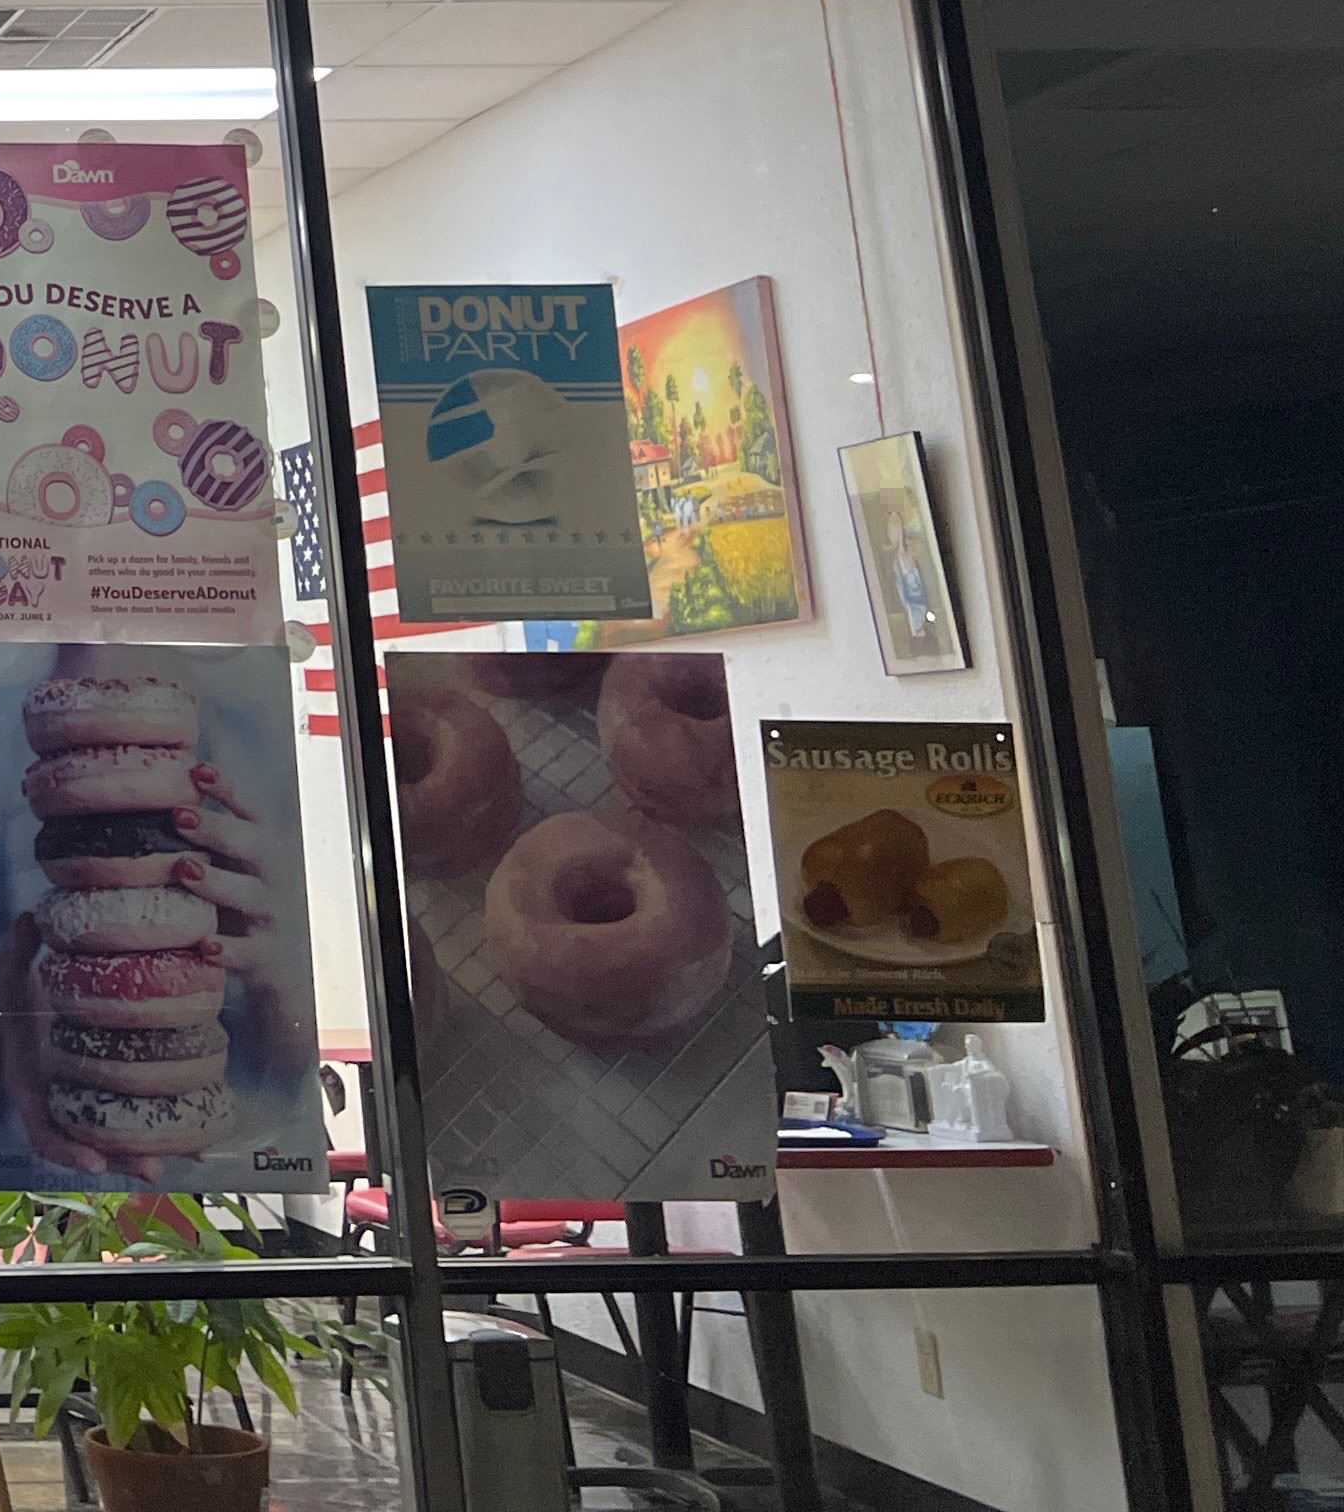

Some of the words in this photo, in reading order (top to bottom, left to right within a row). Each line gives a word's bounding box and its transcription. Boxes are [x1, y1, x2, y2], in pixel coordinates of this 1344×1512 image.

[53, 163, 114, 184] Dawn
[46, 283, 173, 320] DESERVE
[182, 293, 202, 316] A
[418, 295, 588, 332] DONUT
[421, 330, 589, 362] PARTY
[87, 554, 105, 564] Pick
[107, 556, 119, 565] up
[129, 554, 154, 564] dozen
[156, 554, 168, 564] for
[202, 554, 231, 564] friends
[88, 567, 116, 577] others
[118, 568, 137, 576] who
[152, 567, 174, 578] good
[188, 569, 206, 578] your
[90, 585, 257, 601] #YouDeserveADonut
[20, 612, 44, 621] JUNE
[46, 612, 52, 621] 2
[115, 605, 128, 613] the
[767, 741, 915, 777] Sausage
[926, 742, 1012, 773] Rolls
[253, 1149, 312, 1173] Dawn
[711, 1157, 767, 1179] Dawn
